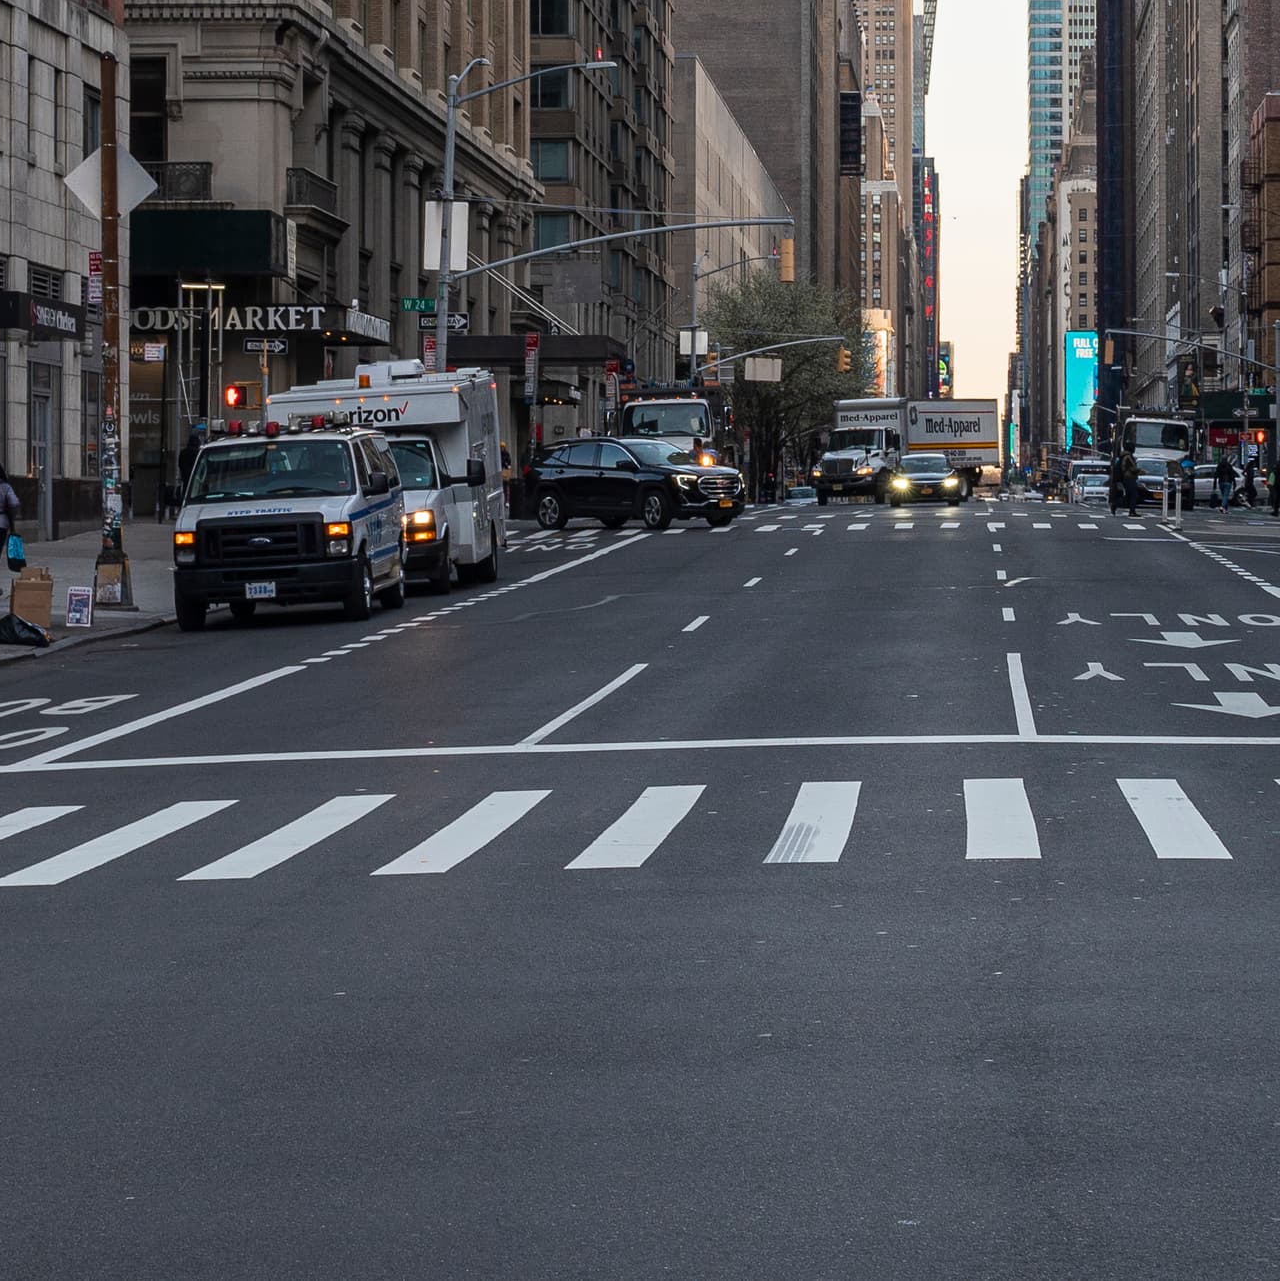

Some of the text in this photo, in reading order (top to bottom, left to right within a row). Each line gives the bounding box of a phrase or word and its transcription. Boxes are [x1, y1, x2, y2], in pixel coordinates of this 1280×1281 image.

[404, 299, 413, 310] W
[415, 299, 426, 310] 24
[1073, 337, 1091, 349] FULL
[1076, 348, 1094, 359] FREE
[128, 407, 160, 425] owls
[346, 403, 401, 425] rizon
[840, 412, 898, 423] Med-Apparel
[925, 417, 981, 437] Med-Apparel
